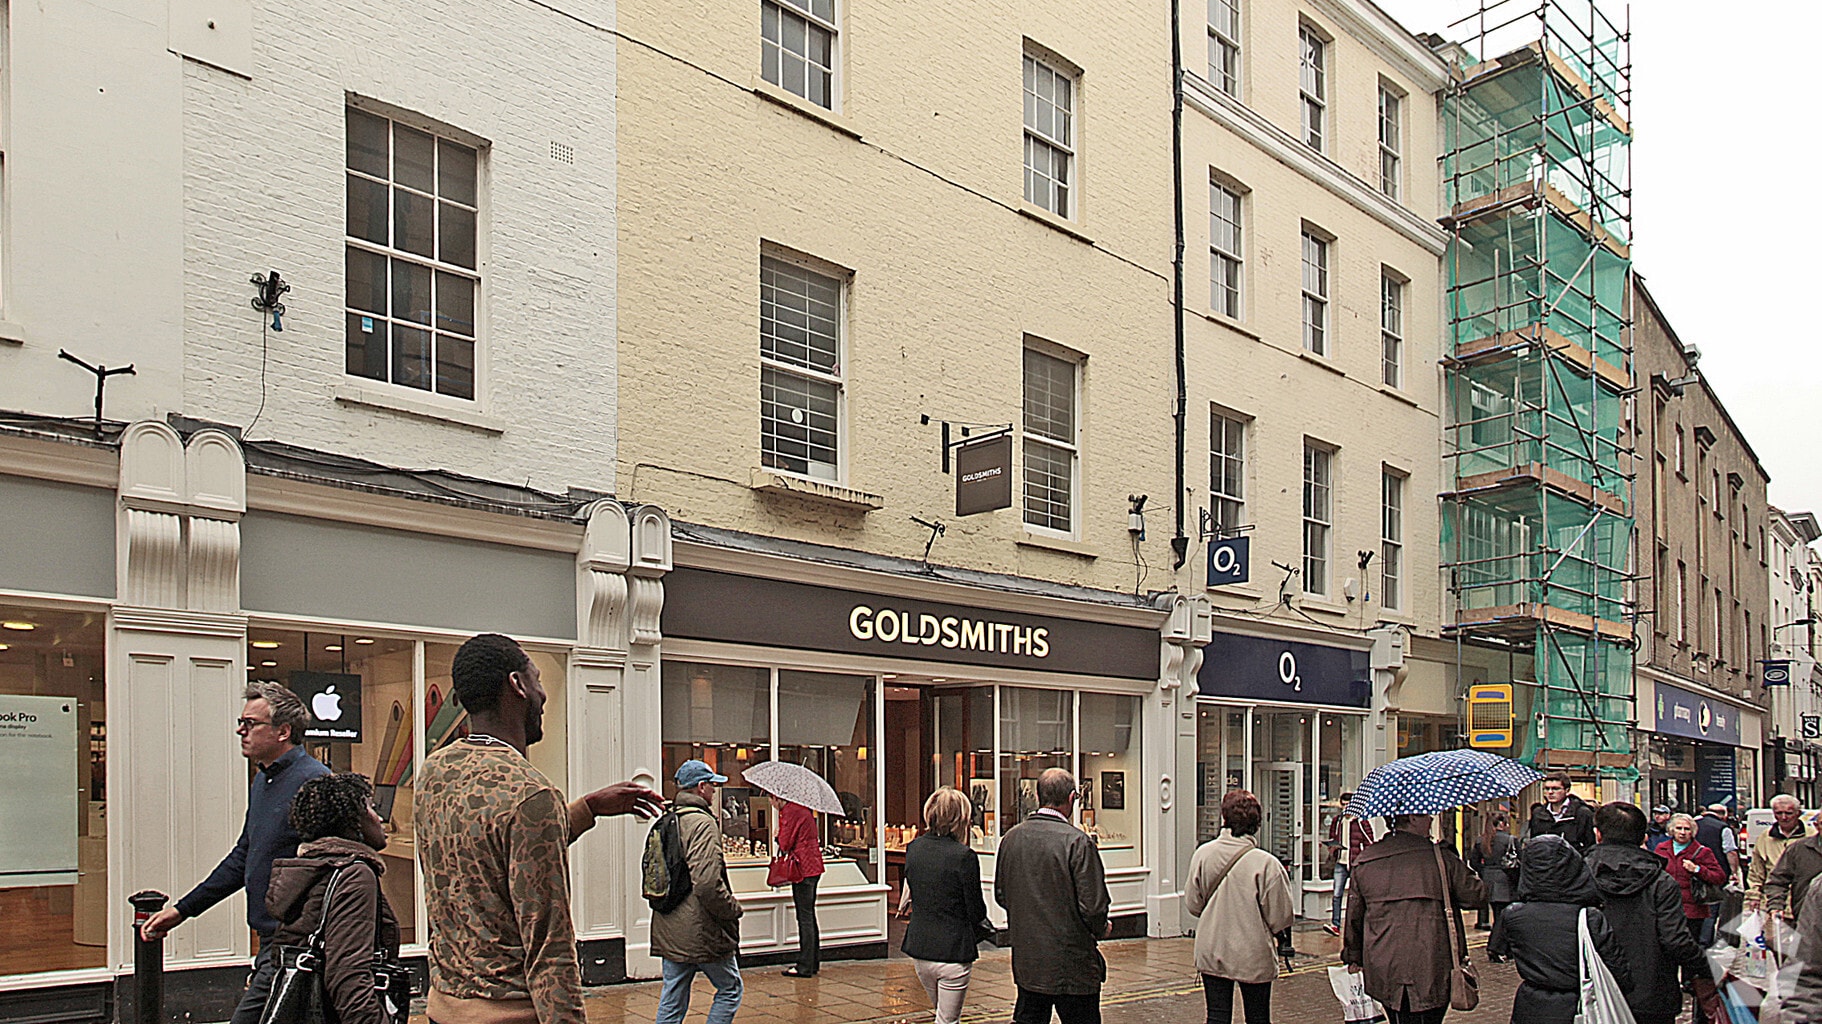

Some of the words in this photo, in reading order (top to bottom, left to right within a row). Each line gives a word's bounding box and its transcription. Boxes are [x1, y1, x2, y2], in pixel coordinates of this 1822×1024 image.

[962, 466, 1002, 482] GOLDSMITHS
[849, 605, 1050, 658] GOLDSMITHS
[19, 712, 37, 723] Pro
